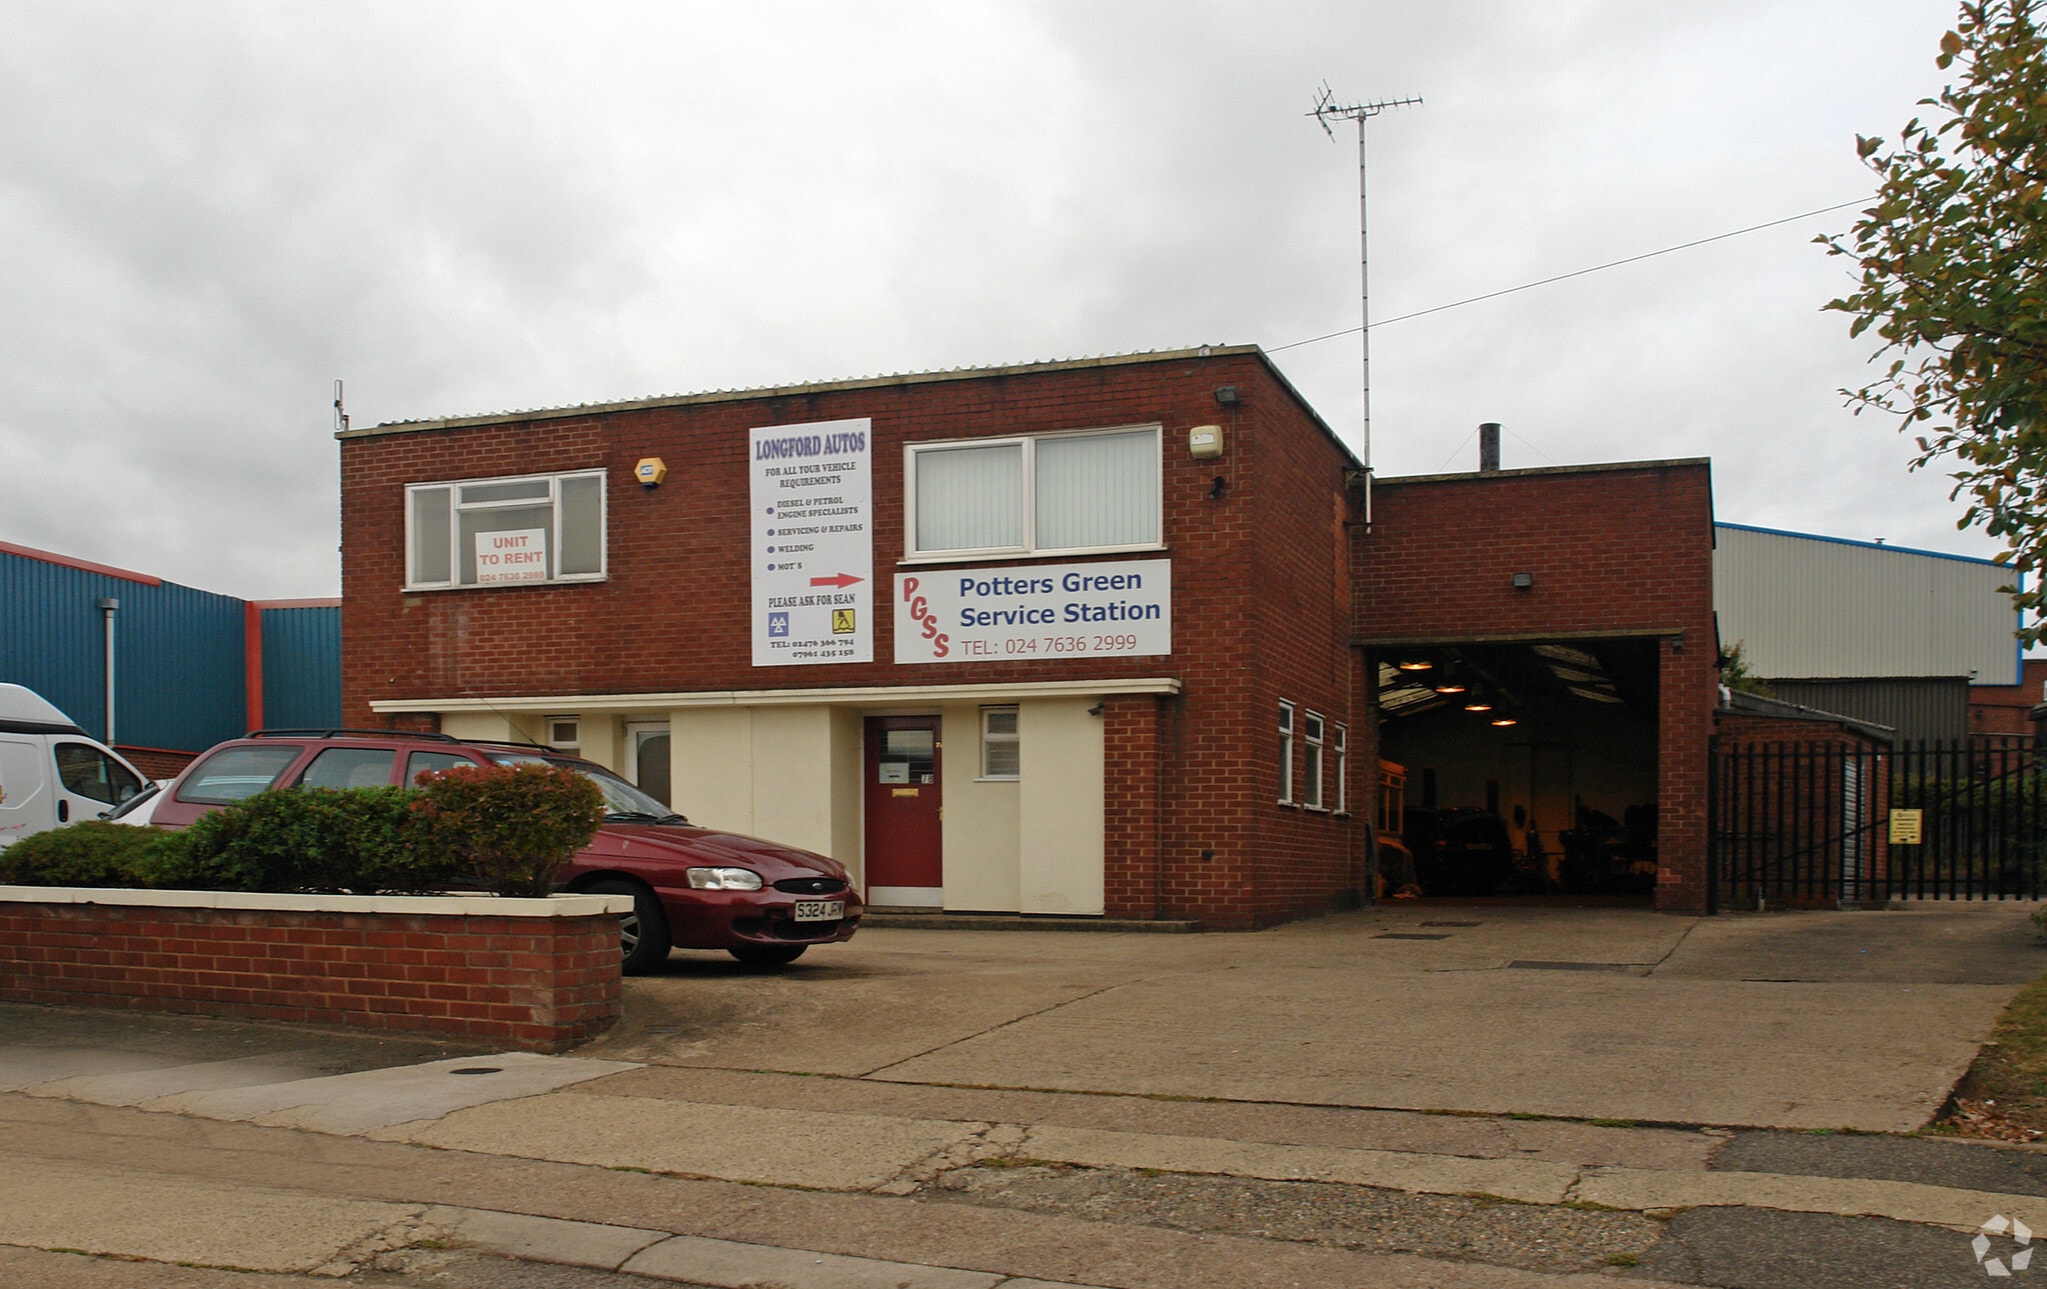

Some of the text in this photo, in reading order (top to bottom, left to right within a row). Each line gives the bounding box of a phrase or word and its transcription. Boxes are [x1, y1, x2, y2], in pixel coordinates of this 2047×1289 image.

[756, 431, 865, 461] LONGFORD AUTOS
[765, 462, 856, 477] FOR ALL YOUR VEHICLE
[780, 475, 841, 488] REQUIREMENTS
[777, 499, 804, 508] DIESEL
[813, 497, 844, 506] PETROL
[777, 507, 859, 519] ENGINE SPECIALISTS
[777, 524, 863, 536] SERVICING & REPAIRS
[493, 536, 528, 548] UNIT
[777, 544, 814, 553] WELDING
[480, 552, 543, 565] TO RENT
[960, 573, 1142, 597] Potters Green
[768, 593, 856, 608] PLEASE ASK FOR SEAN
[960, 600, 1161, 627] Service Station
[961, 634, 1137, 655] TEL: 024 7636 2999
[797, 903, 826, 917] S324
